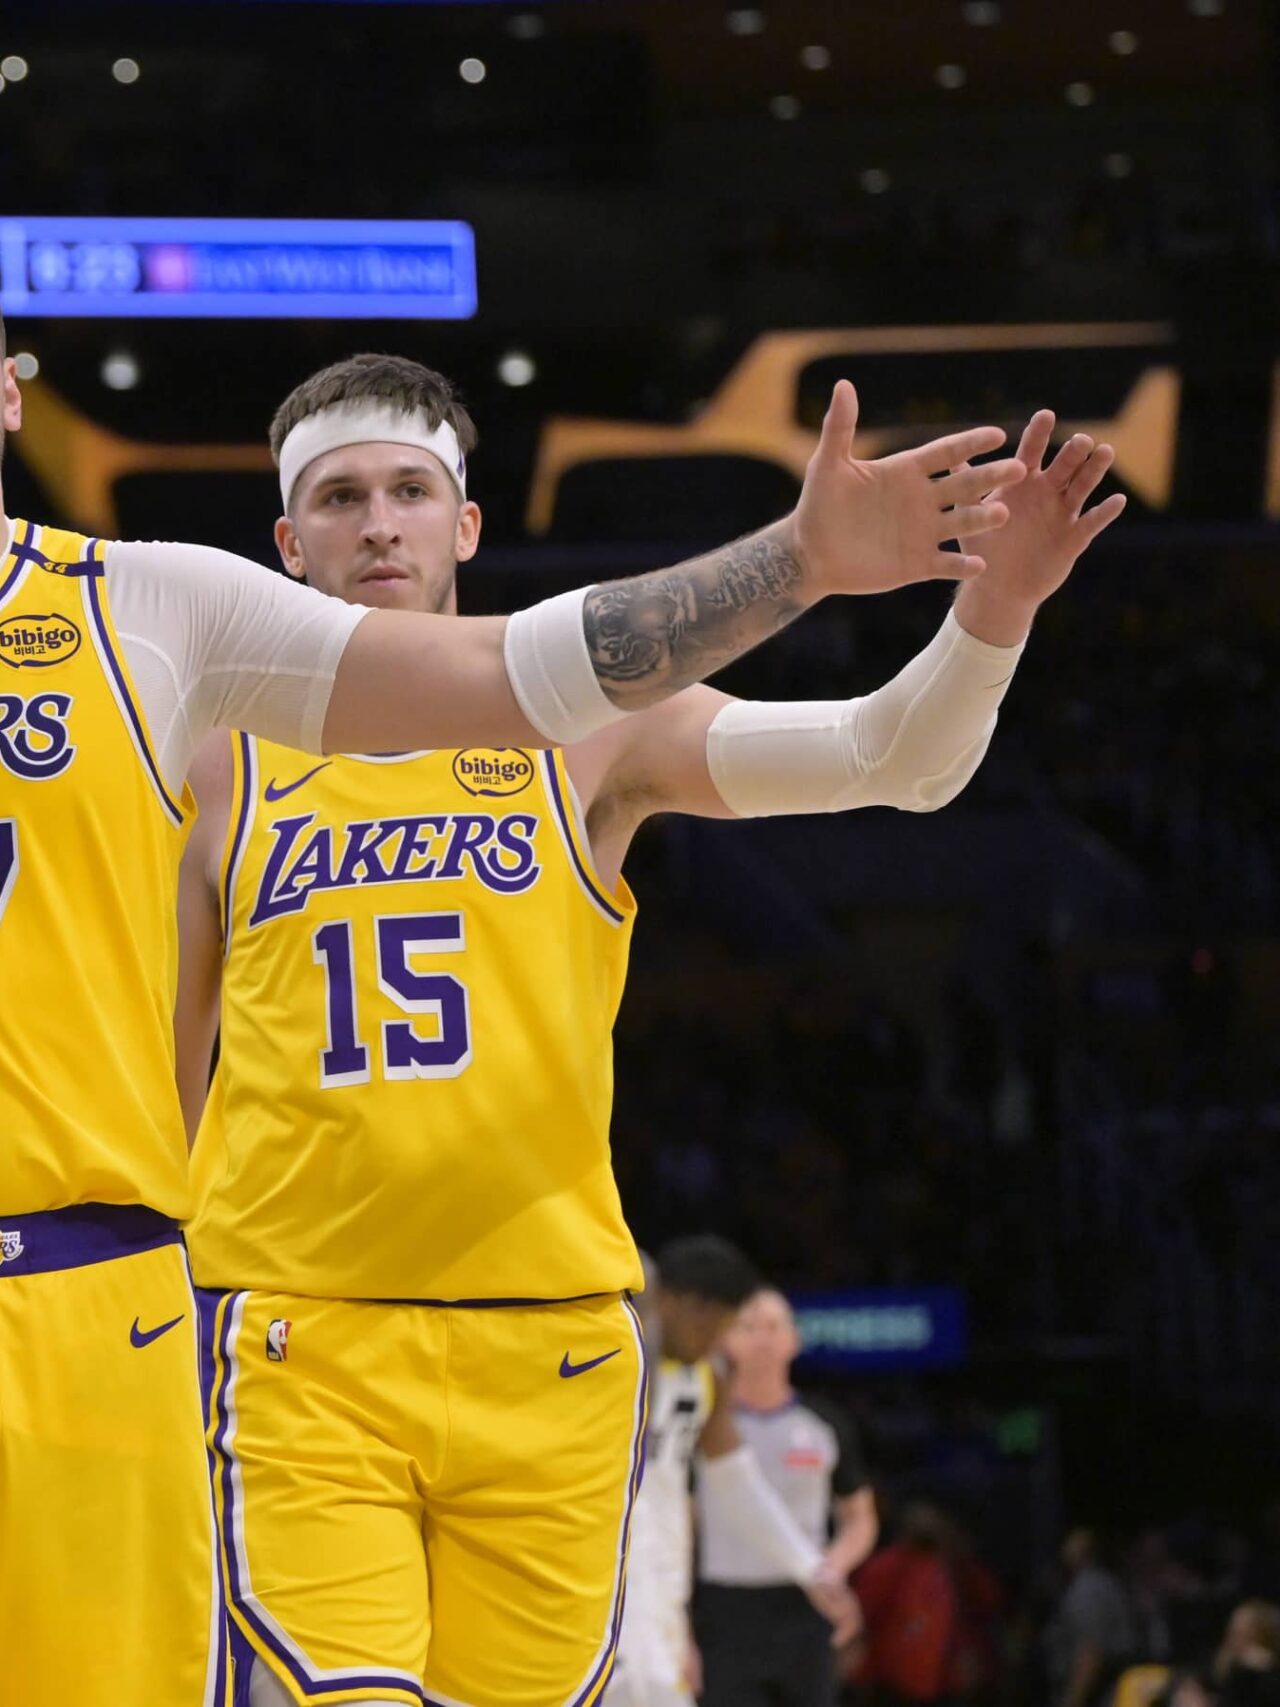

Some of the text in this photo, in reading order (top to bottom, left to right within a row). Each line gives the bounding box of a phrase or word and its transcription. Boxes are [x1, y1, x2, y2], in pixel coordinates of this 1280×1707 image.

[460, 757, 529, 781] bibigo
[247, 811, 543, 931] LAKERS
[312, 911, 473, 1089] 15
